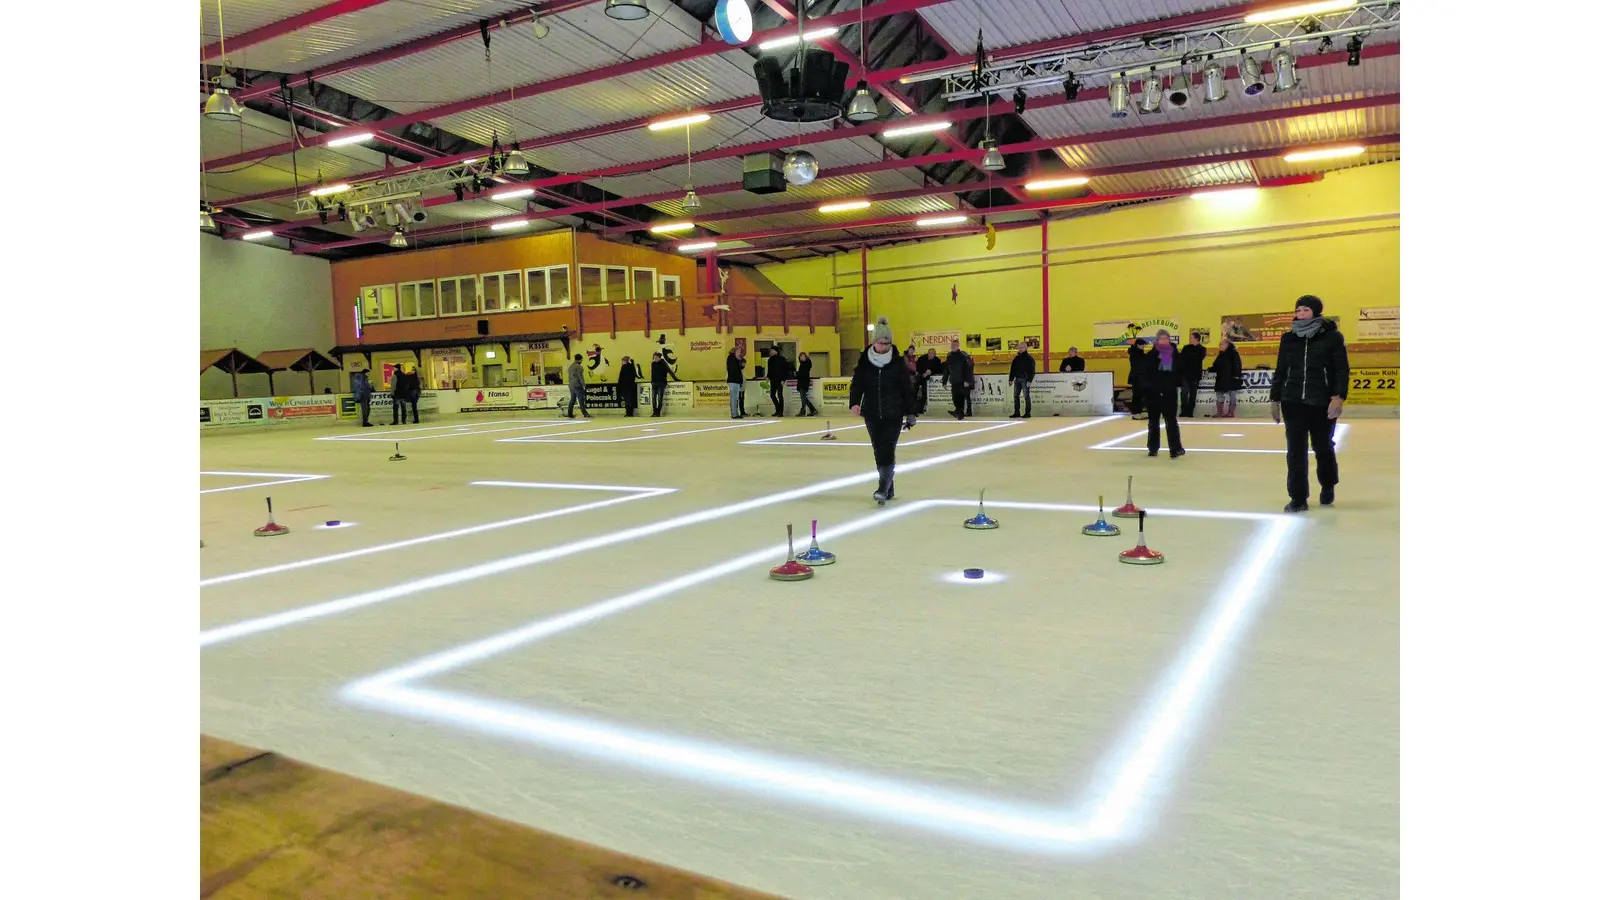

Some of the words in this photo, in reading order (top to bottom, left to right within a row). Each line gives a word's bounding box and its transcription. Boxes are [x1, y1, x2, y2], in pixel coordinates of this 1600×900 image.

[1241, 372, 1274, 388] RUN
[1353, 379, 1371, 389] 22
[1377, 379, 1395, 389] 22
[824, 383, 847, 391] WEIKERT
